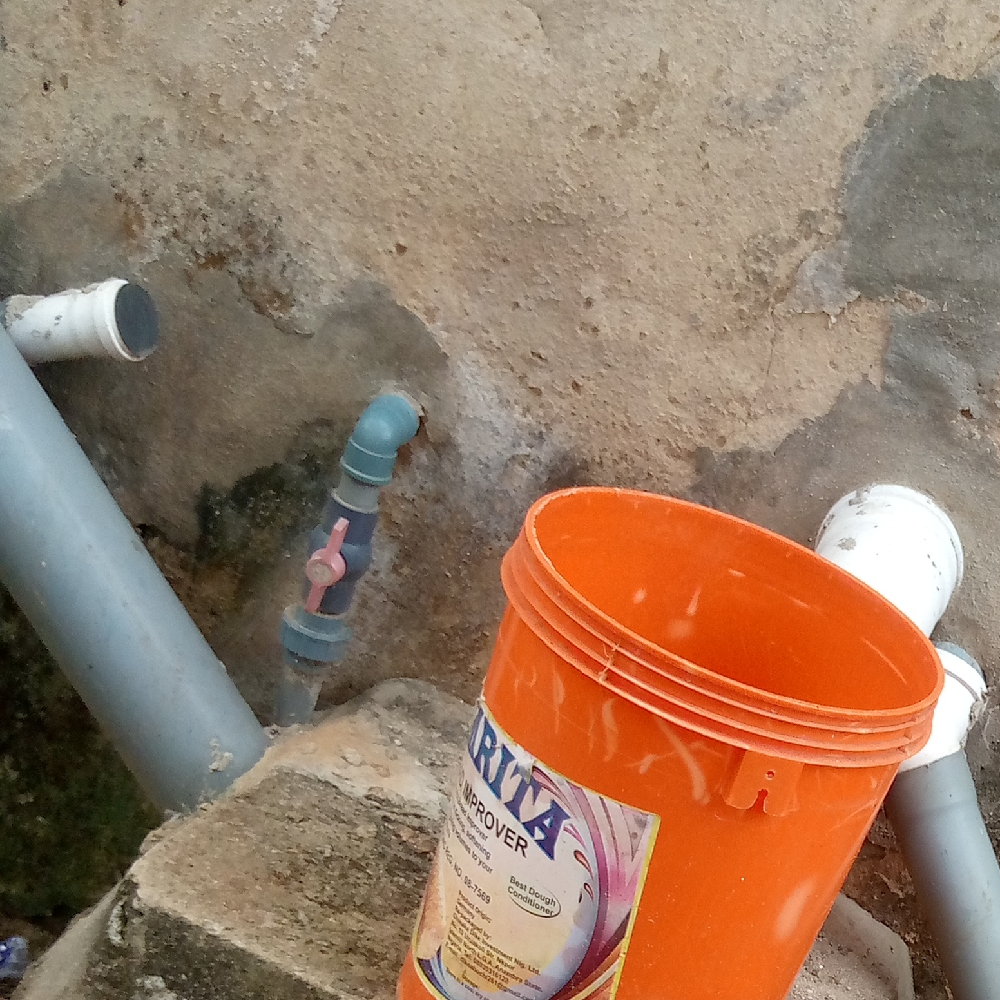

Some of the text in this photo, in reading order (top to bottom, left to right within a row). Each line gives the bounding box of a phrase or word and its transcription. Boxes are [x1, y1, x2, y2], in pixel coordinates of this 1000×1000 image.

[463, 779, 528, 858] IMPROVER
[507, 885, 554, 917] Conditioner
[510, 875, 556, 908] Best Dough
